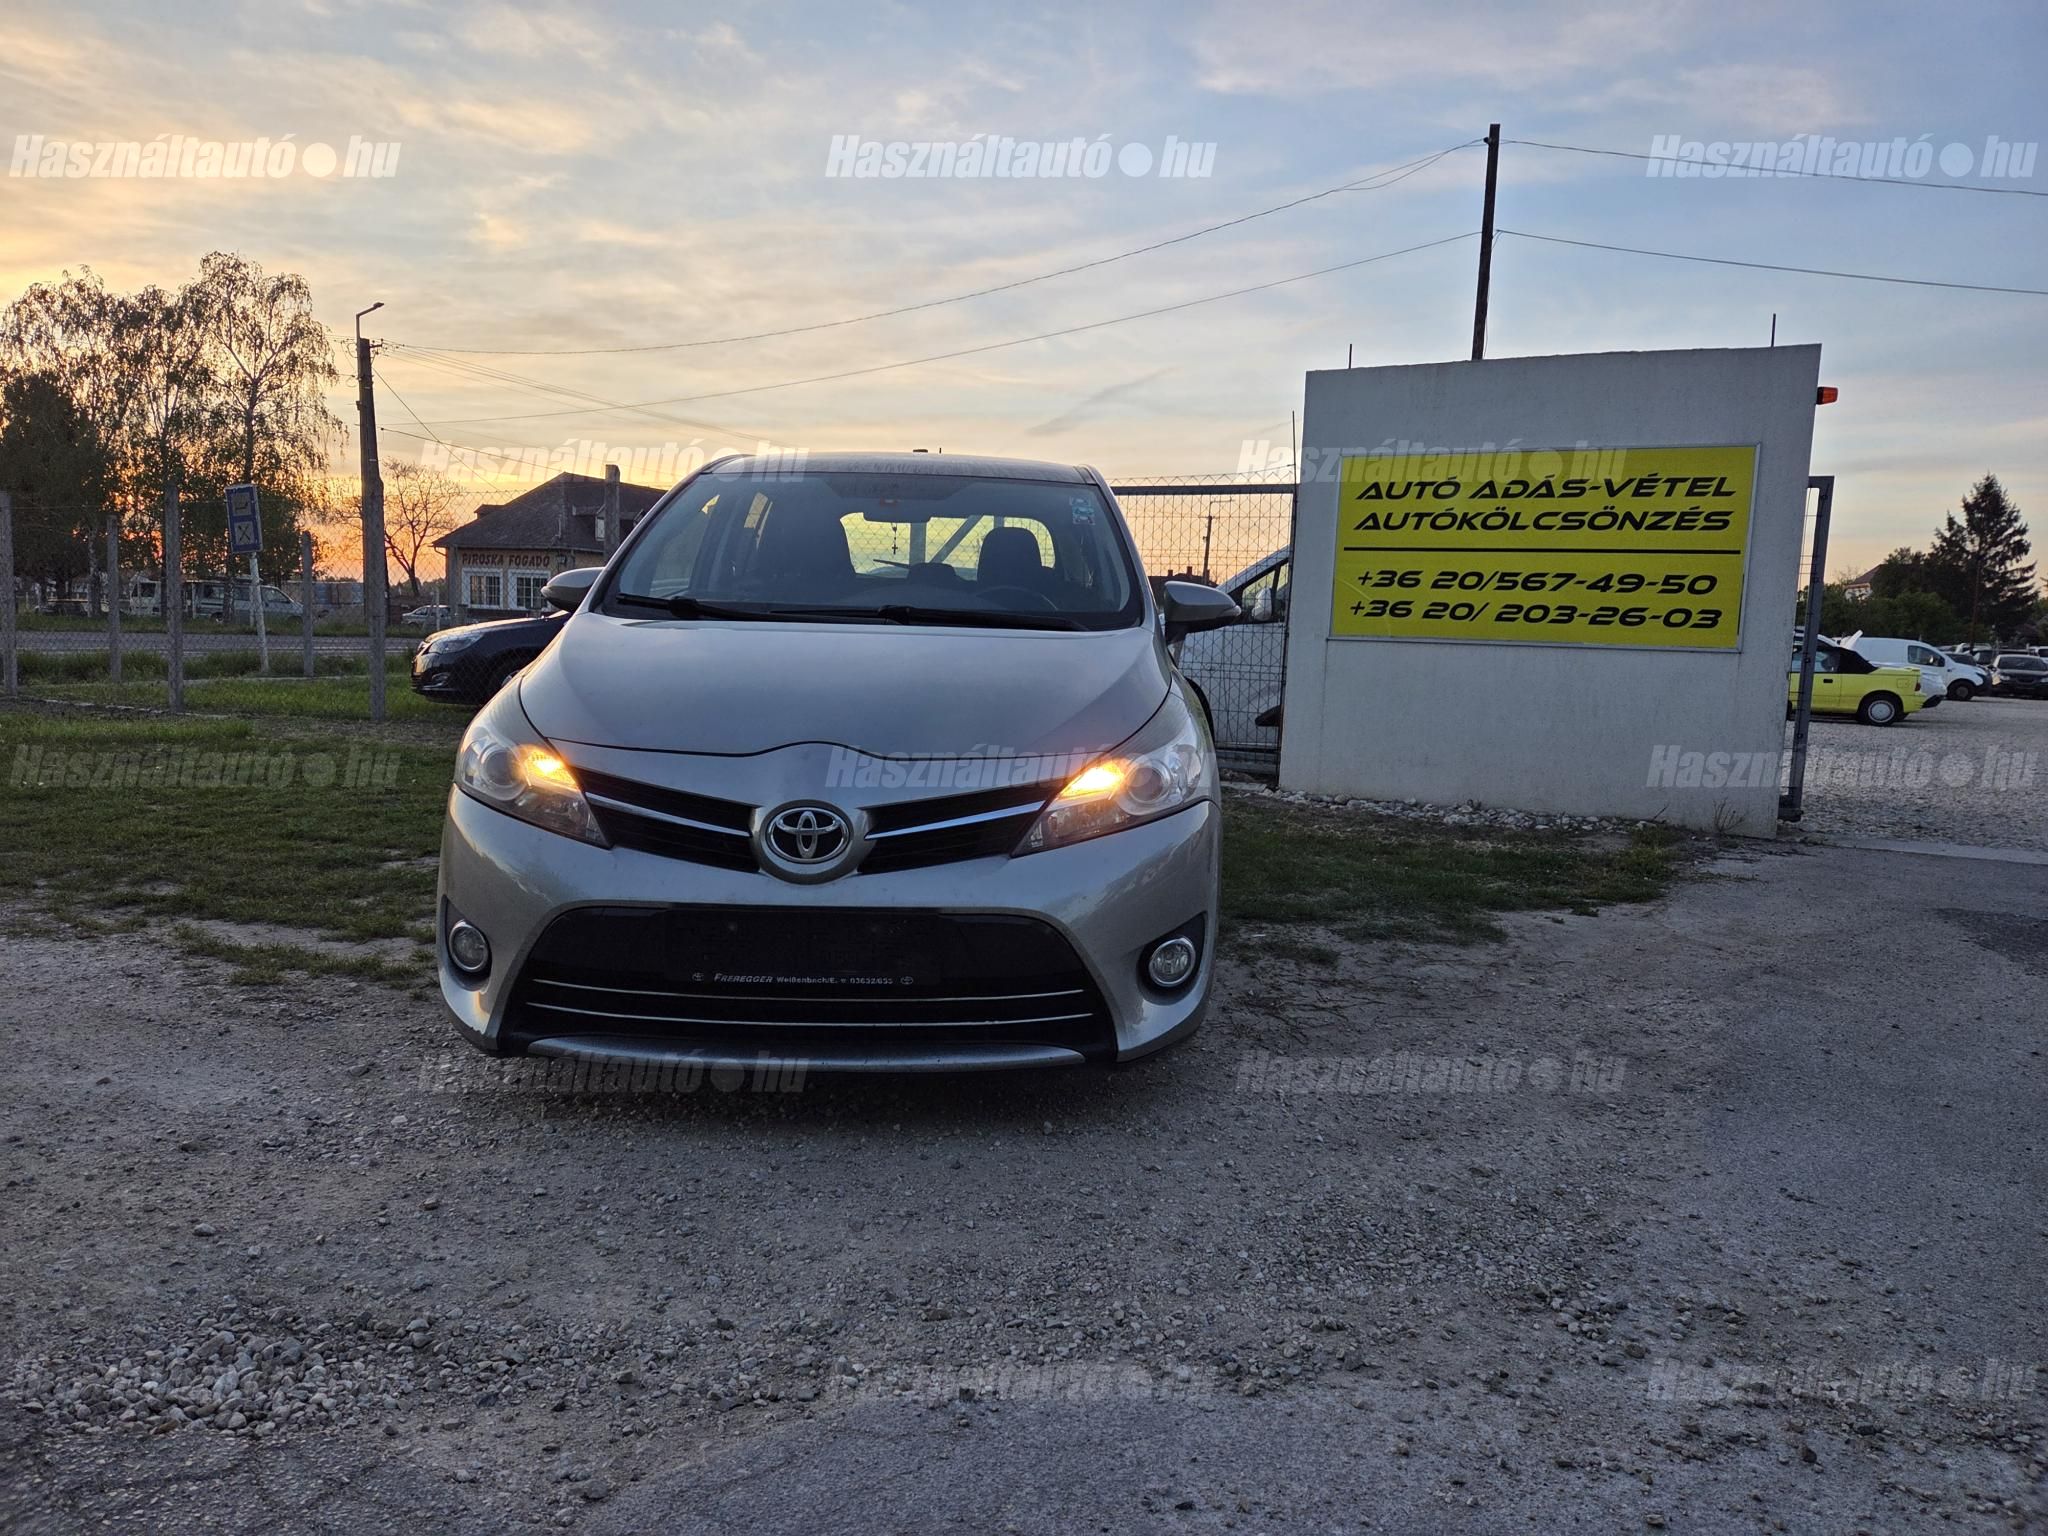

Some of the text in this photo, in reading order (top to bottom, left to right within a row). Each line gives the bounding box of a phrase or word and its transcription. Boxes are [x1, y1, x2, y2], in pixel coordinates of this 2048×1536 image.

[1356, 472, 1737, 500] AUTÓ ADÁS-VÉTEL
[1353, 505, 1735, 532] AUTÓKÖLCSÖNZÉS
[462, 553, 504, 566] PIROSKA
[1357, 569, 1718, 596] +36 20/567-49-50
[1350, 599, 1723, 630] +36 20/ 203-26-03
